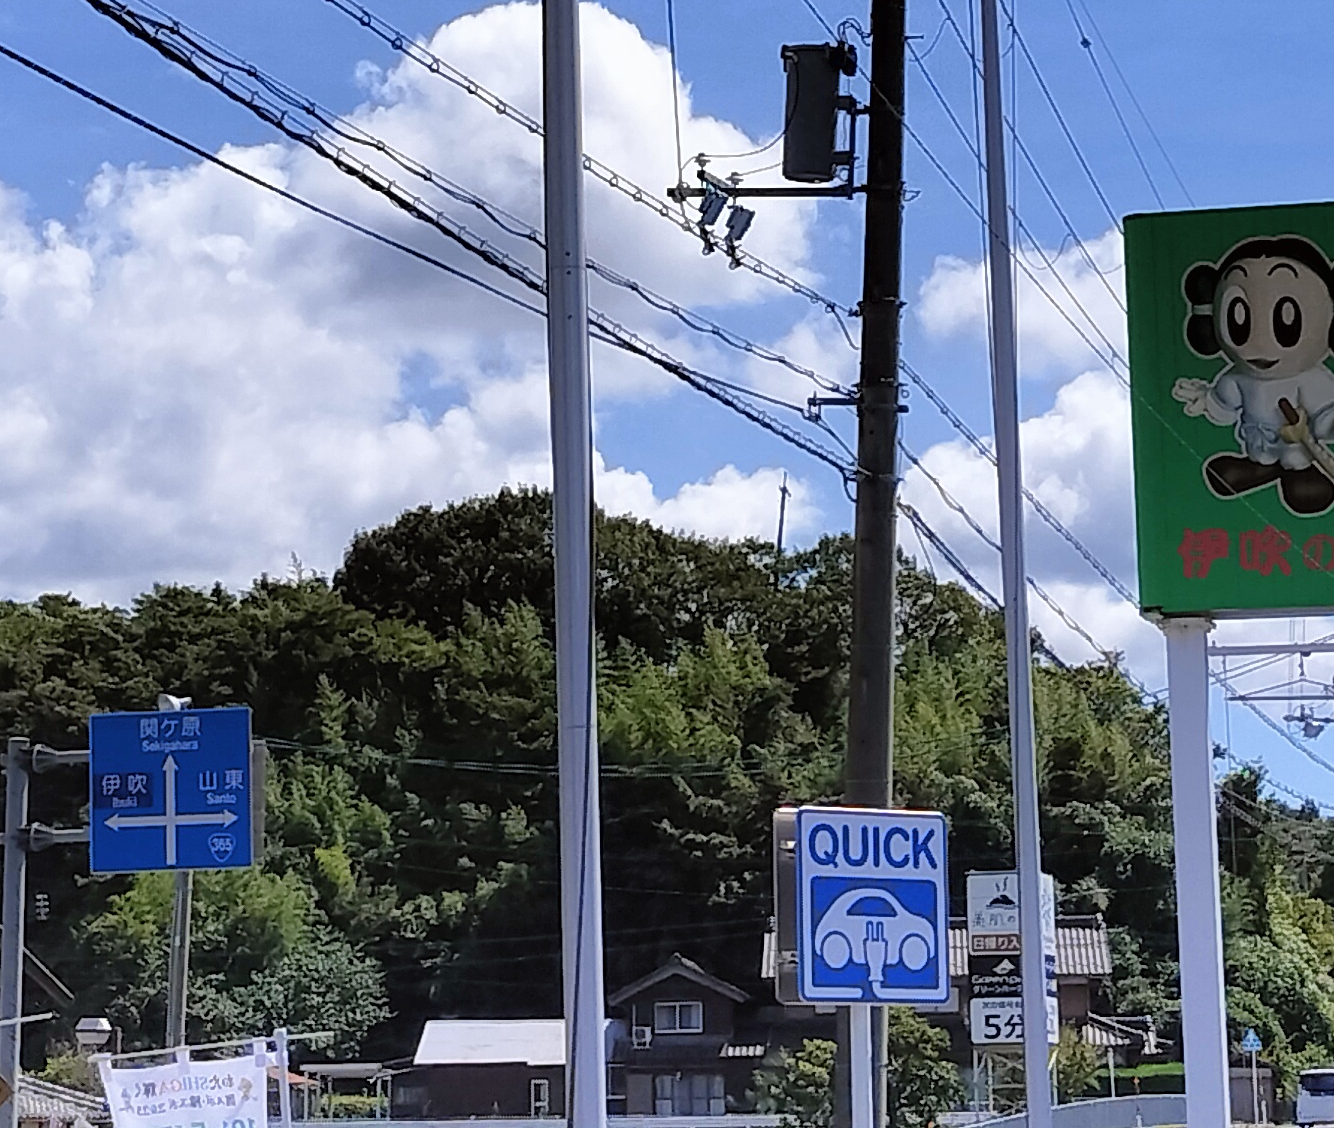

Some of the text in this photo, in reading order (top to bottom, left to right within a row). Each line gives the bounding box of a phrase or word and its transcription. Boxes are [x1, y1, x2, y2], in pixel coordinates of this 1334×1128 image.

[139, 716, 201, 739] 関ケ原
[142, 740, 198, 753] Sekigahara
[101, 773, 147, 795] 伊吹
[199, 769, 244, 791] 山東
[211, 837, 233, 851] 365
[808, 823, 938, 869] QUICK
[984, 1014, 1024, 1039] 5分
